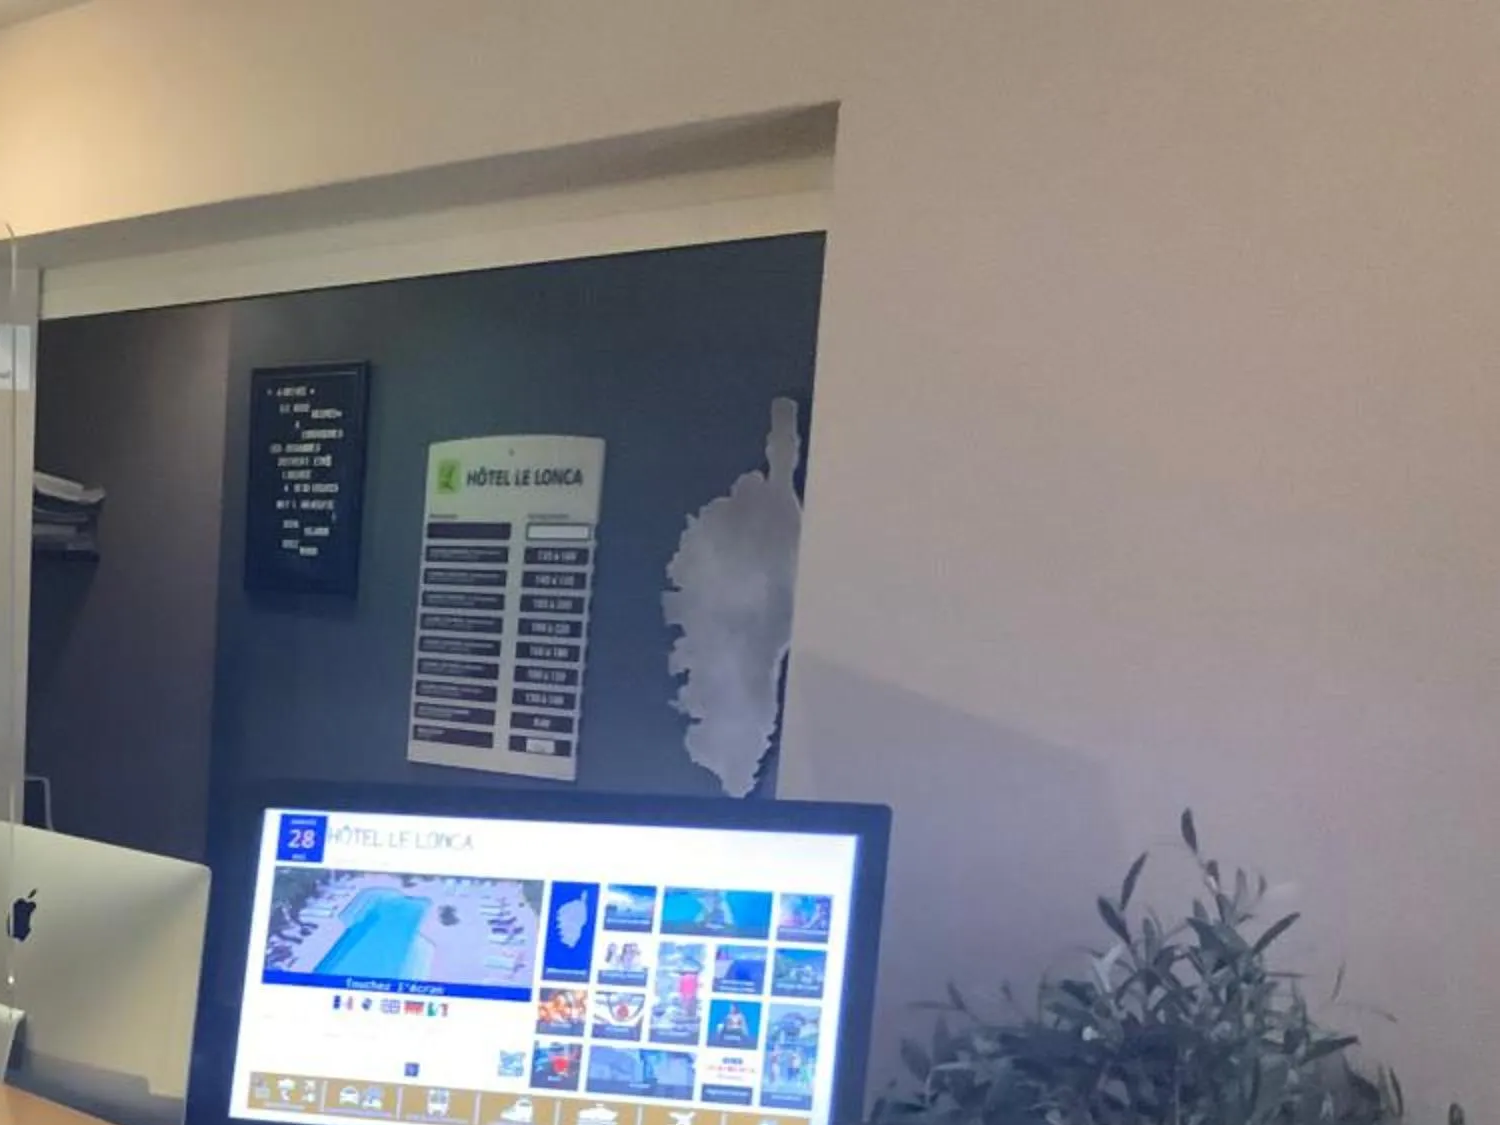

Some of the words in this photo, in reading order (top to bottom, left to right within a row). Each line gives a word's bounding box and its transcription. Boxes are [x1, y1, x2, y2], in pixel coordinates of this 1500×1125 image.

[467, 465, 510, 487] HÔTEL
[514, 470, 531, 486] LE
[534, 468, 583, 486] LONCA
[288, 829, 315, 849] 28
[329, 825, 383, 848] HÔTEL
[389, 830, 410, 848] LE
